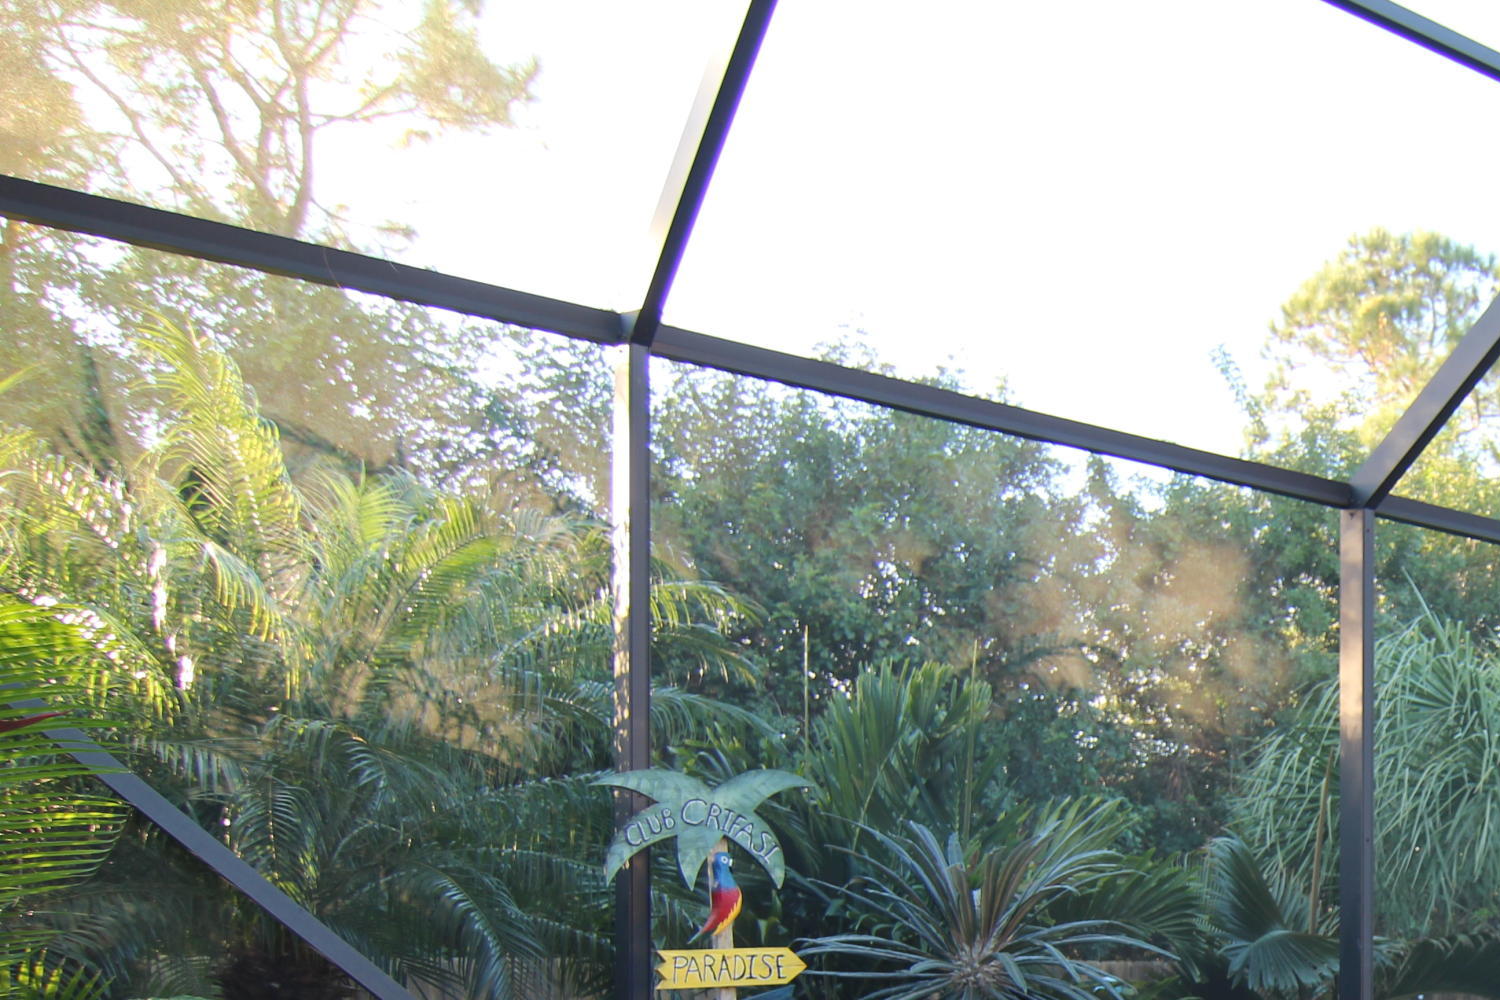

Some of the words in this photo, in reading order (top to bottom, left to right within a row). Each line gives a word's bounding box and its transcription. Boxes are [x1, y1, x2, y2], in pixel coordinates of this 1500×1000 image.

[625, 808, 676, 846] CLUB
[681, 798, 781, 865] CRIFASI
[672, 954, 787, 984] PARADISE
